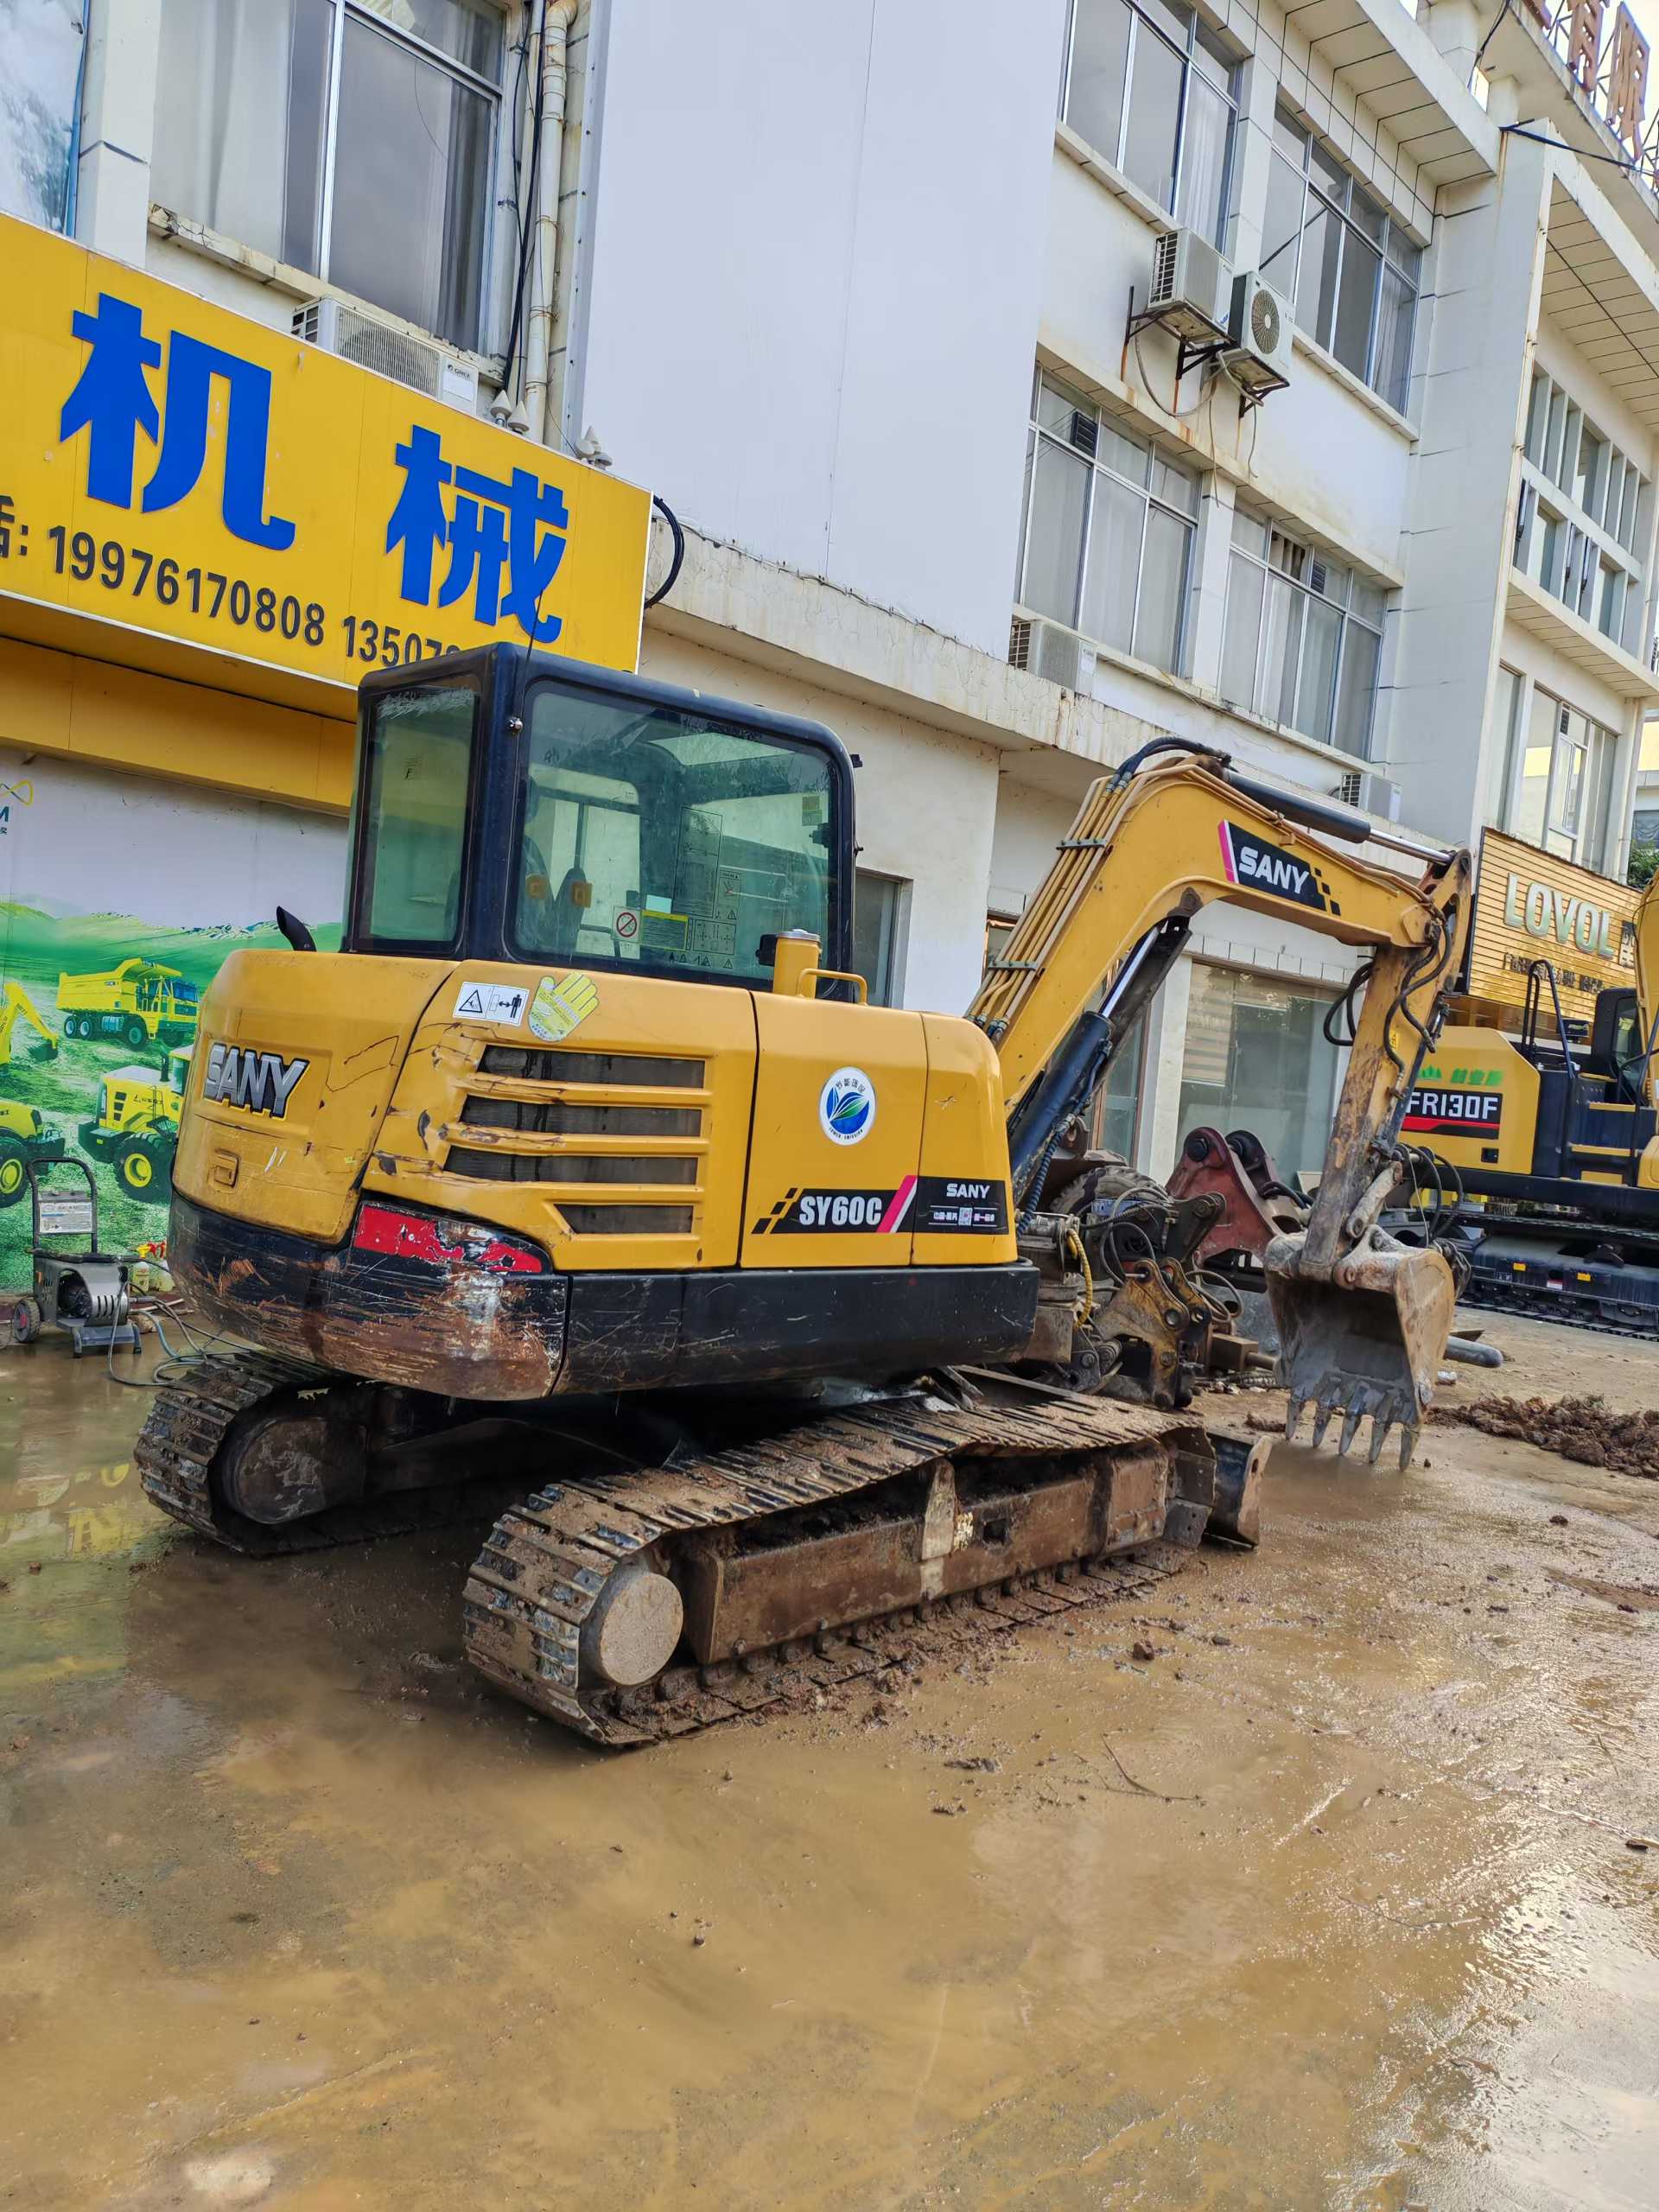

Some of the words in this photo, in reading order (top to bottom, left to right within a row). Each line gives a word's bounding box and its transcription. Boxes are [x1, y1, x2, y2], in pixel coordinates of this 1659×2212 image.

[48, 525, 326, 646] 19976170808
[342, 614, 461, 668] 13507
[1238, 846, 1310, 894] SANY
[1503, 873, 1615, 961] LOVOL
[203, 1043, 309, 1118] SANY
[1405, 1091, 1499, 1120] FR130F
[798, 1196, 882, 1226] SY60C
[946, 1183, 991, 1199] SANY
